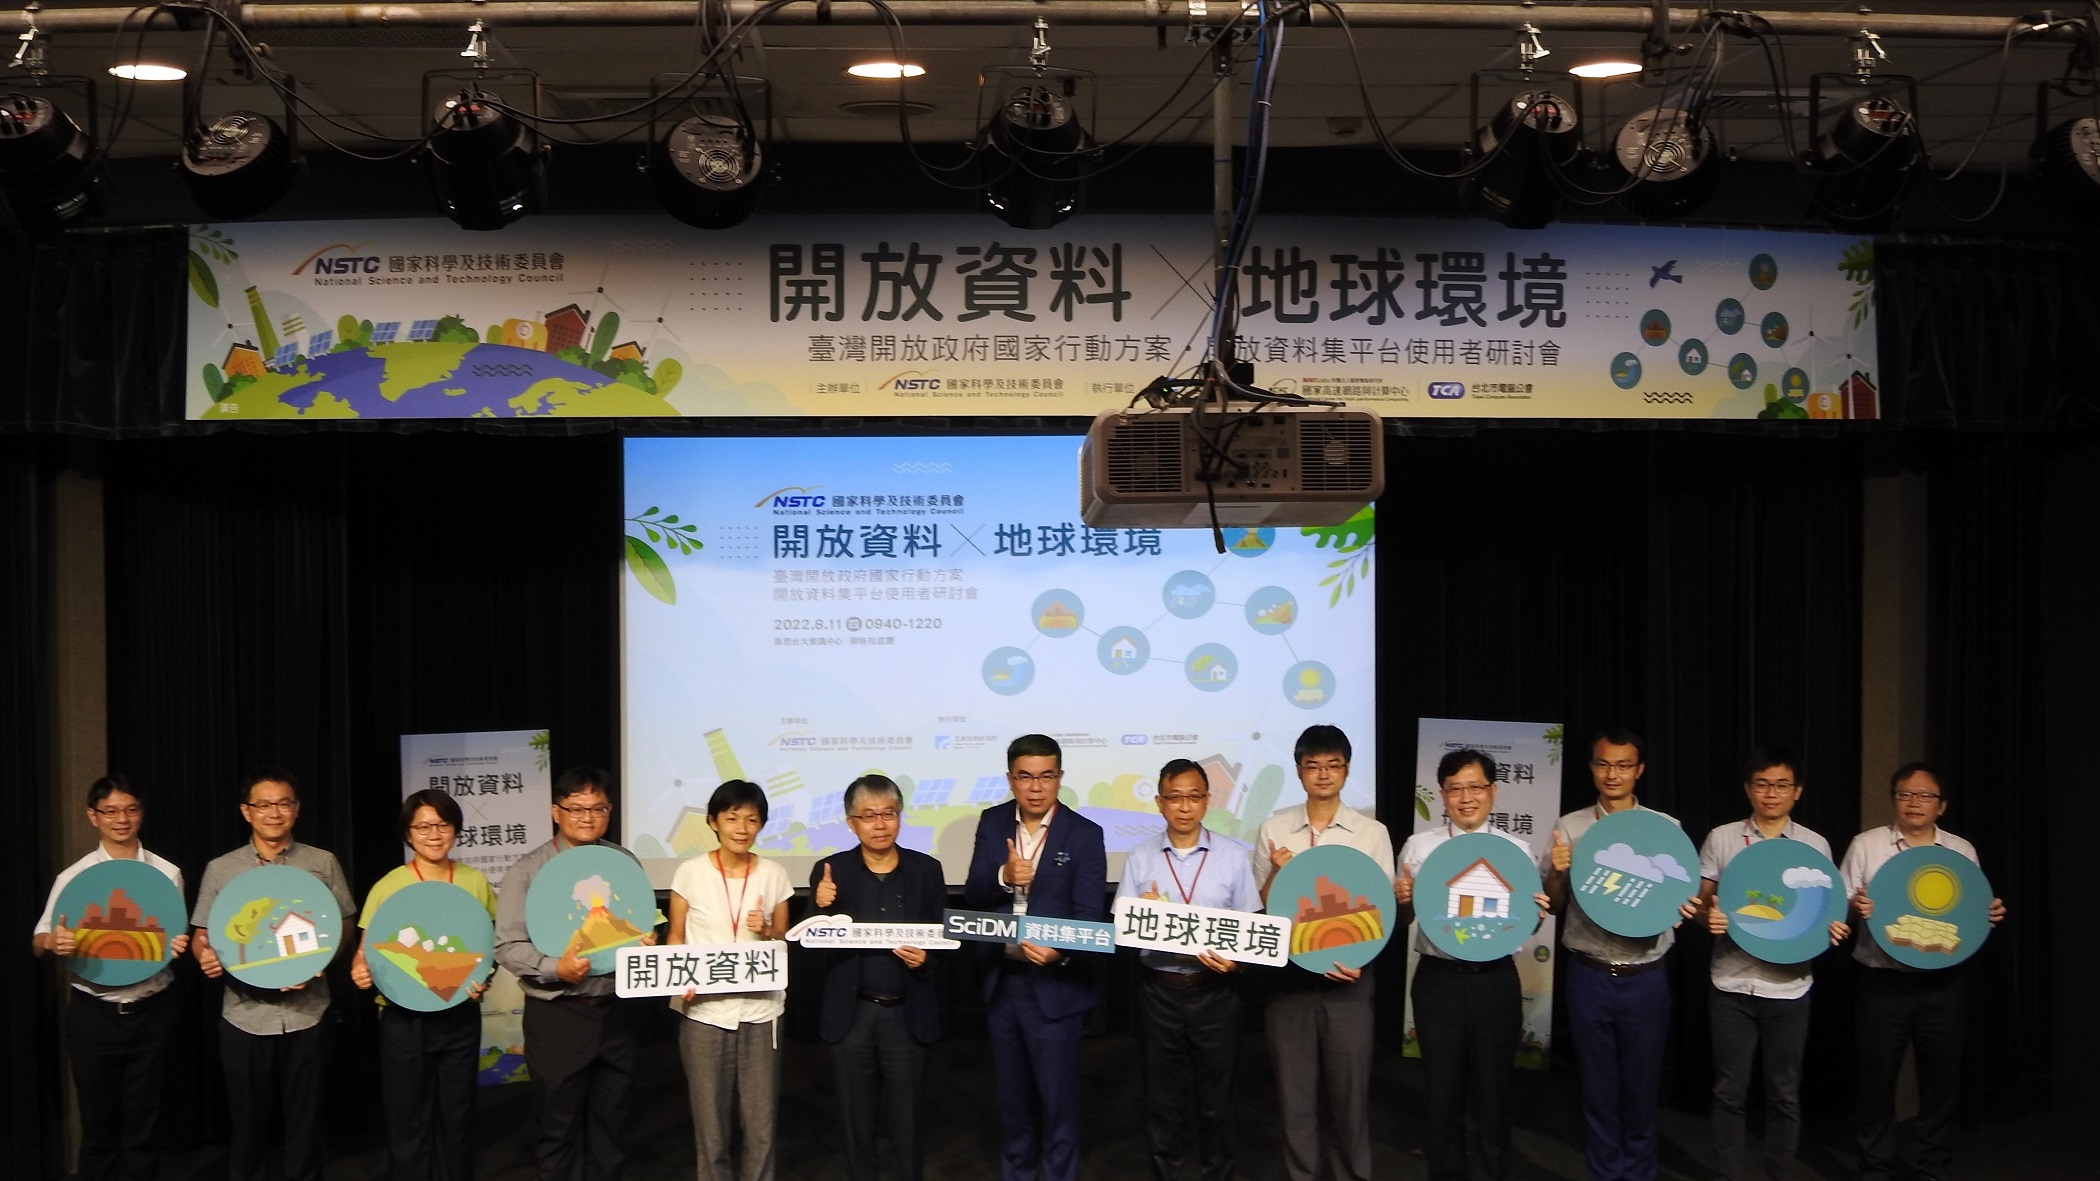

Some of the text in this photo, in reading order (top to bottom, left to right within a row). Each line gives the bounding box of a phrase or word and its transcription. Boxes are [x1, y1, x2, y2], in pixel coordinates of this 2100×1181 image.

[314, 252, 565, 275] NSTC 國家科學及技術委員會
[314, 273, 564, 287] National Science and Technology Council
[769, 241, 1567, 329] 開放資料 地球環境
[816, 382, 860, 394] 主辦單位
[894, 378, 1064, 391] NSTC 國家科學及技術委員會
[1091, 382, 1134, 394] 執行單位
[1432, 384, 1460, 396] TCA
[985, 391, 1030, 399] Technology
[773, 494, 965, 508] NSTC 國家科學及技術委員會
[876, 508, 926, 516] Technology
[930, 507, 964, 515] Council
[774, 522, 1162, 559] 開放資料 地球環境
[773, 568, 964, 583] 臺灣開放政府國家行動方案
[773, 586, 978, 601] 開放資料集平台使用者研討會
[774, 618, 842, 631] 2022.8.11
[865, 618, 943, 630] 0940-1220
[780, 737, 817, 746] NSTC
[1494, 762, 1535, 785] 資料
[456, 823, 527, 848] 球環境
[806, 927, 848, 937] NSTC
[948, 914, 1112, 948] SciDM 資料集平台
[1122, 905, 1282, 958] 地球環境
[627, 948, 779, 989] 開放資料
